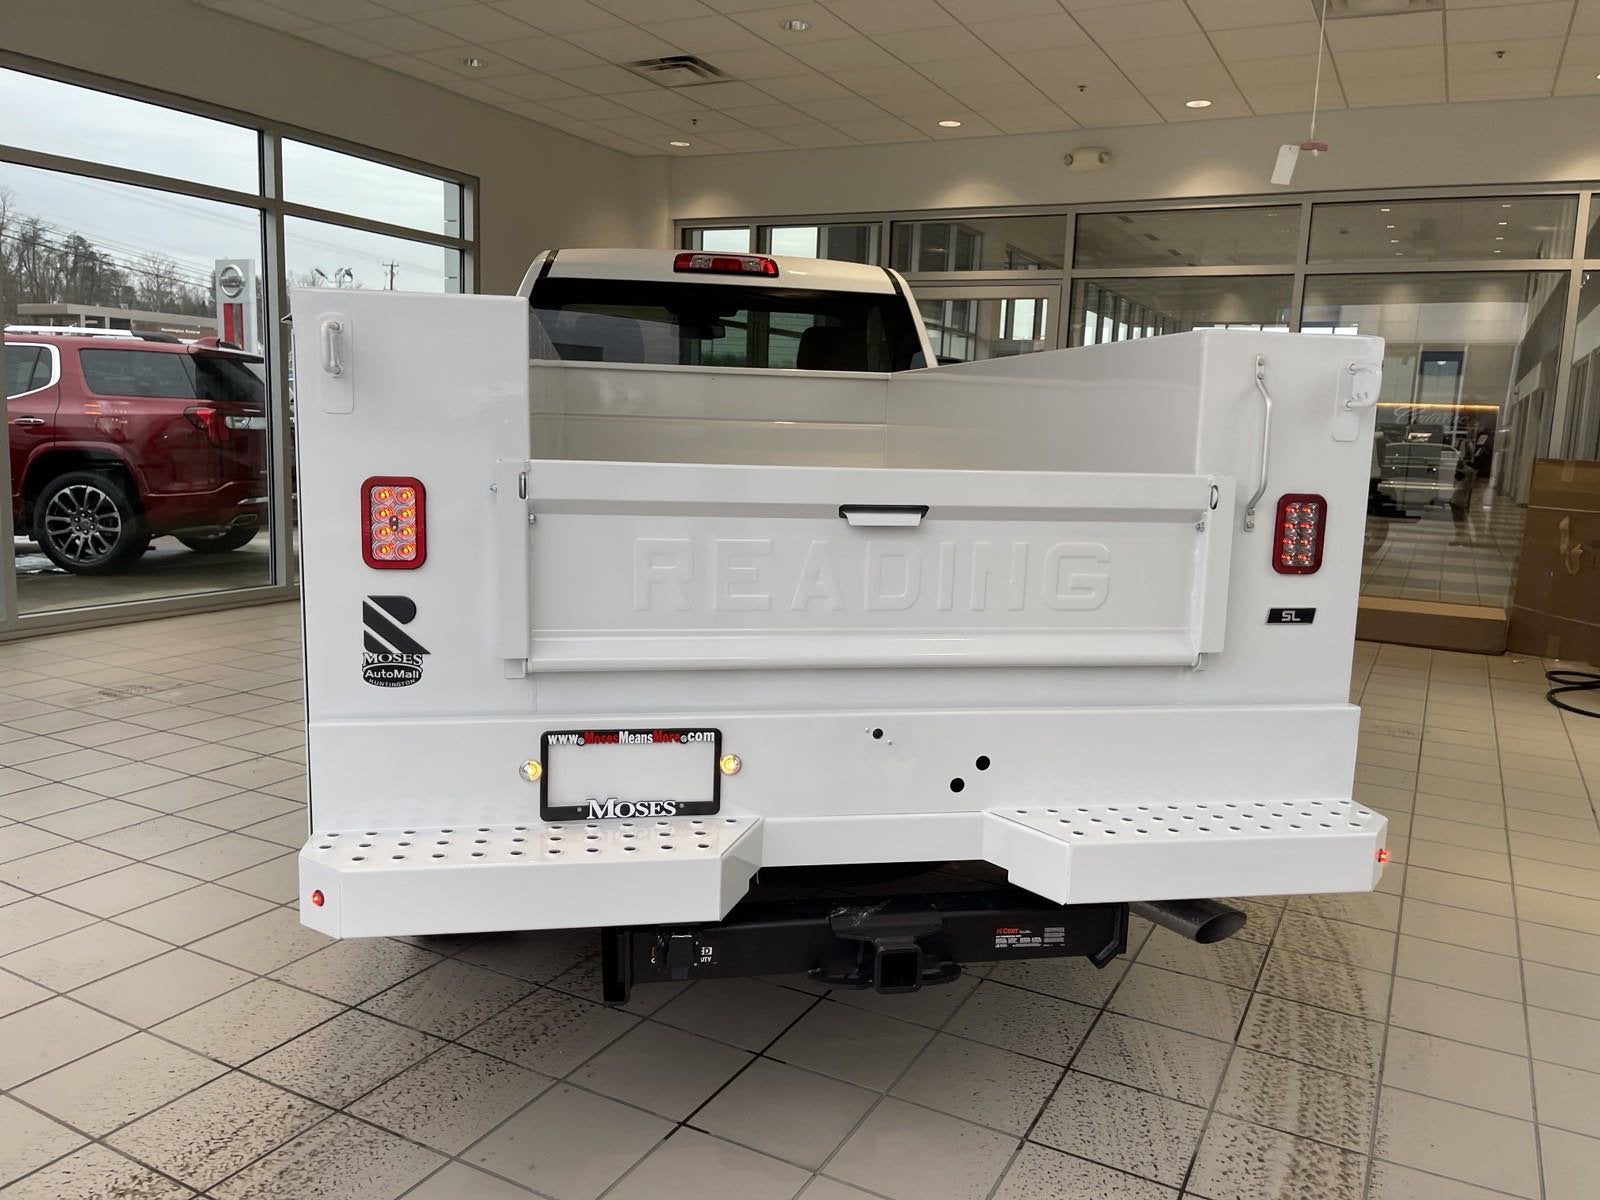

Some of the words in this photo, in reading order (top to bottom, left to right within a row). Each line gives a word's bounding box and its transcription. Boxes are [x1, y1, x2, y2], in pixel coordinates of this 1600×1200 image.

[632, 537, 1112, 613] READING
[1281, 610, 1301, 622] SL
[362, 652, 424, 667] MOSES
[364, 669, 420, 679] AutoMall
[368, 678, 417, 687] HUNTINGTON
[585, 798, 677, 820] MOSES
